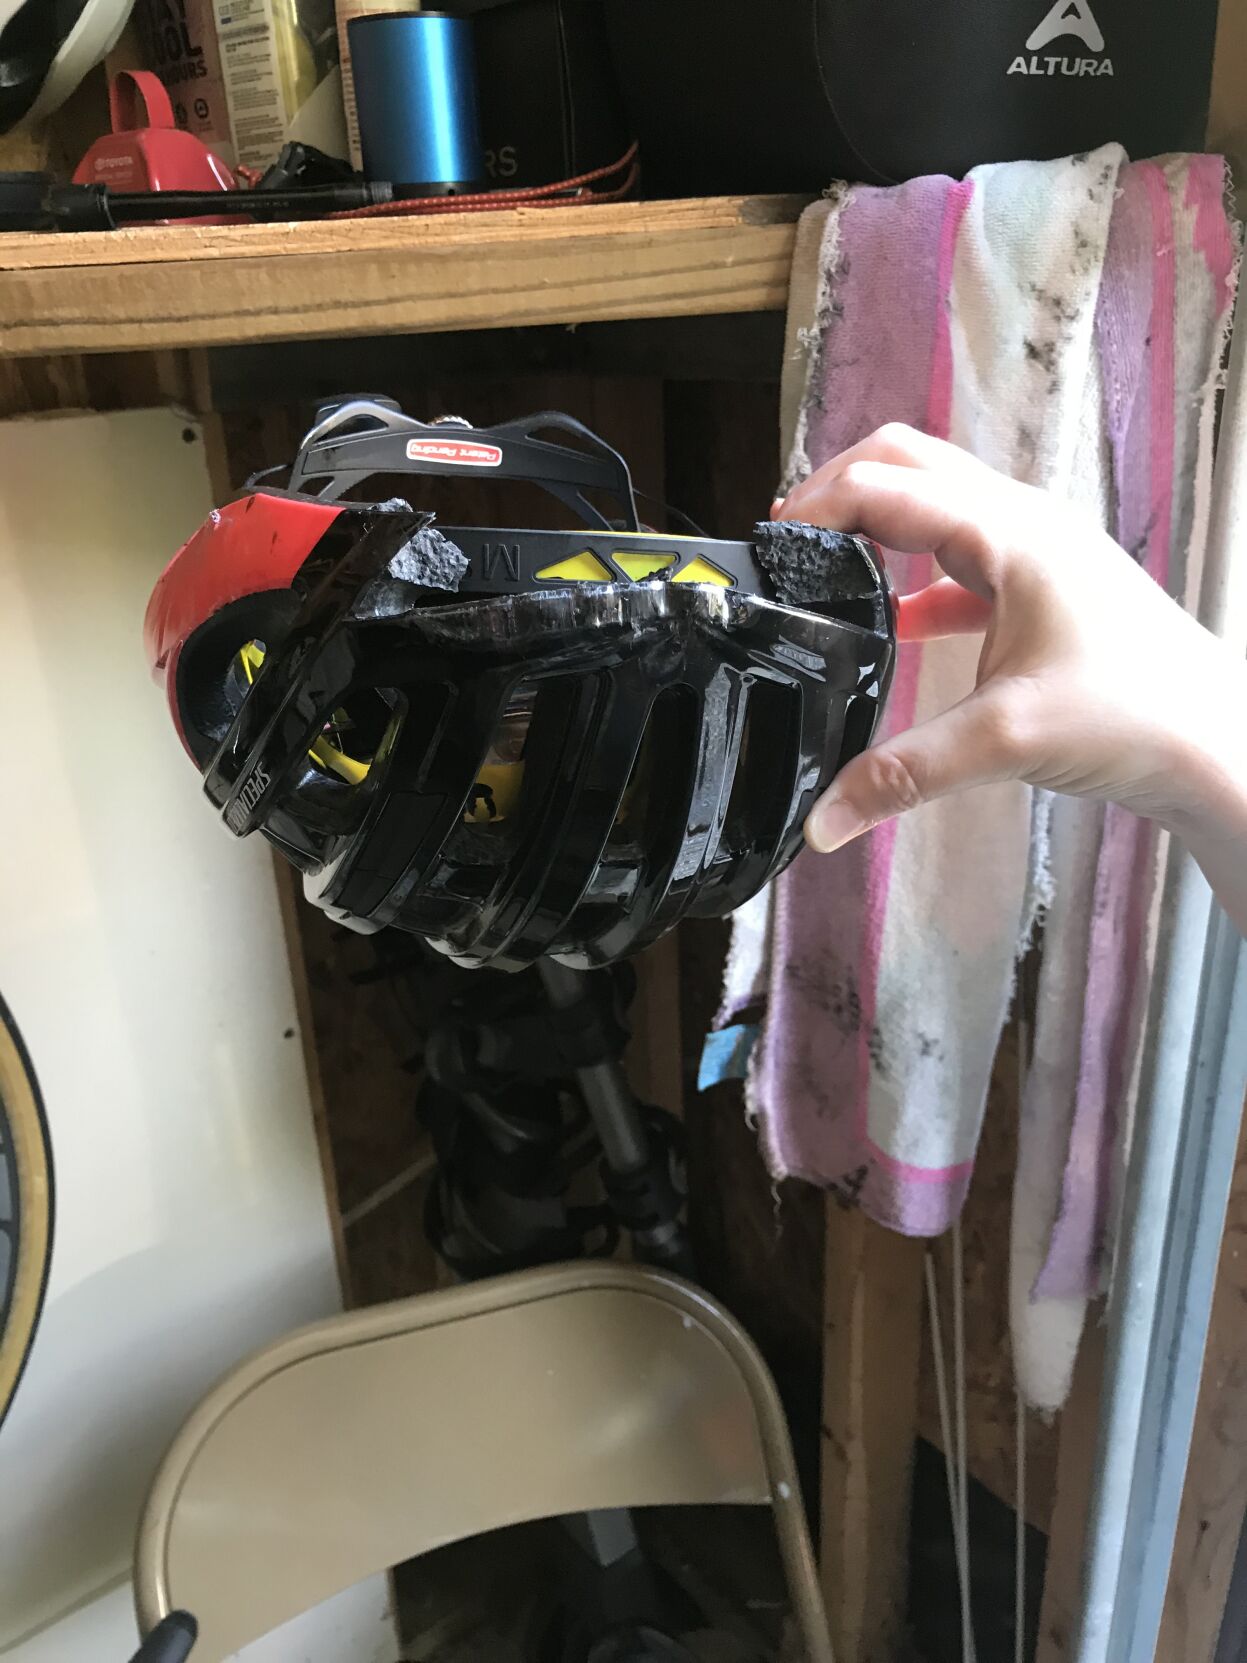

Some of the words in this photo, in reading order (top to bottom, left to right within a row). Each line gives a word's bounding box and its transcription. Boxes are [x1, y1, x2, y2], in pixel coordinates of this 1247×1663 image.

[1006, 56, 1114, 76] ALTURA
[410, 443, 457, 457] Pending
[459, 448, 497, 461] Patent
